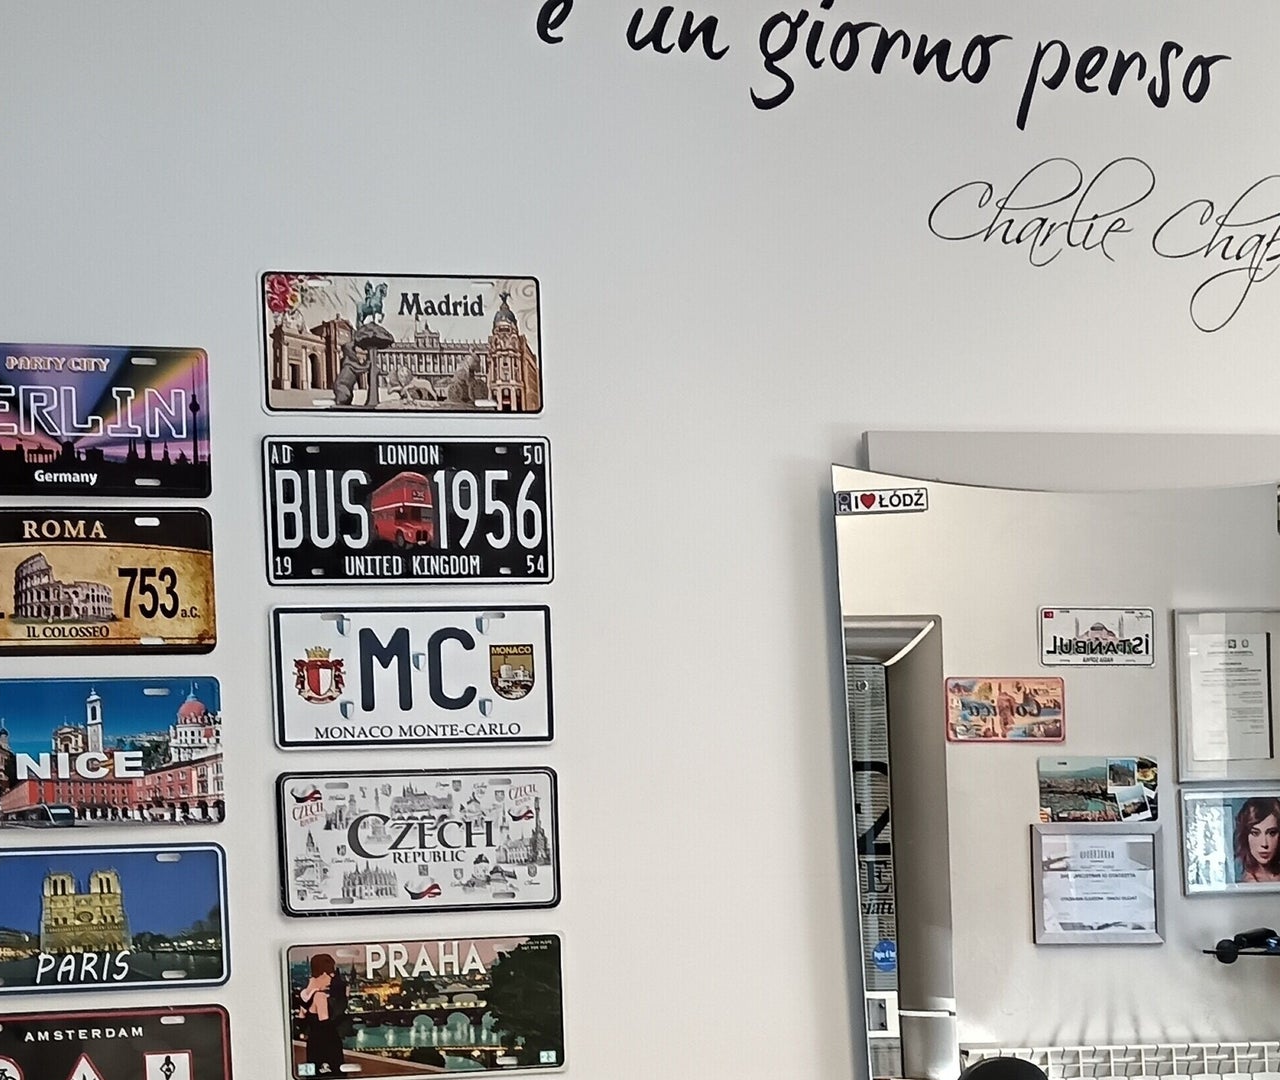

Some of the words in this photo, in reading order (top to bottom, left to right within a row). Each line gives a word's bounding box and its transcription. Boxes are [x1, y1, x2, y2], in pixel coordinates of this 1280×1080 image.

[626, 6, 729, 61] un
[749, 0, 1013, 110] giorno
[1016, 37, 1232, 131] perso
[928, 157, 1156, 267] Charlie
[398, 293, 484, 317] Madrid
[6, 356, 67, 371] PARTY
[69, 357, 109, 372] CITY
[379, 445, 440, 464] LONDON
[523, 446, 543, 464] 50
[34, 470, 98, 486] Germany
[275, 469, 369, 549] BUS
[433, 470, 543, 550] 1956
[855, 496, 858, 509] I
[22, 520, 107, 539] ROMA
[275, 557, 292, 575] 19
[346, 556, 402, 576] UNITED
[413, 556, 480, 576] KINGDOM
[526, 555, 544, 573] 54
[118, 567, 180, 619] 753
[26, 626, 40, 637] IL
[42, 625, 109, 638] COLOSSEO
[315, 726, 393, 739] MONACO
[398, 723, 521, 737] MONTE-CARLO
[16, 751, 144, 780] NICE
[347, 813, 496, 859] CZECH
[393, 851, 466, 864] REPUBLIC
[36, 951, 131, 984] PARIS
[365, 941, 487, 980] PRAHA
[24, 1026, 144, 1042] AMSTERDAM
